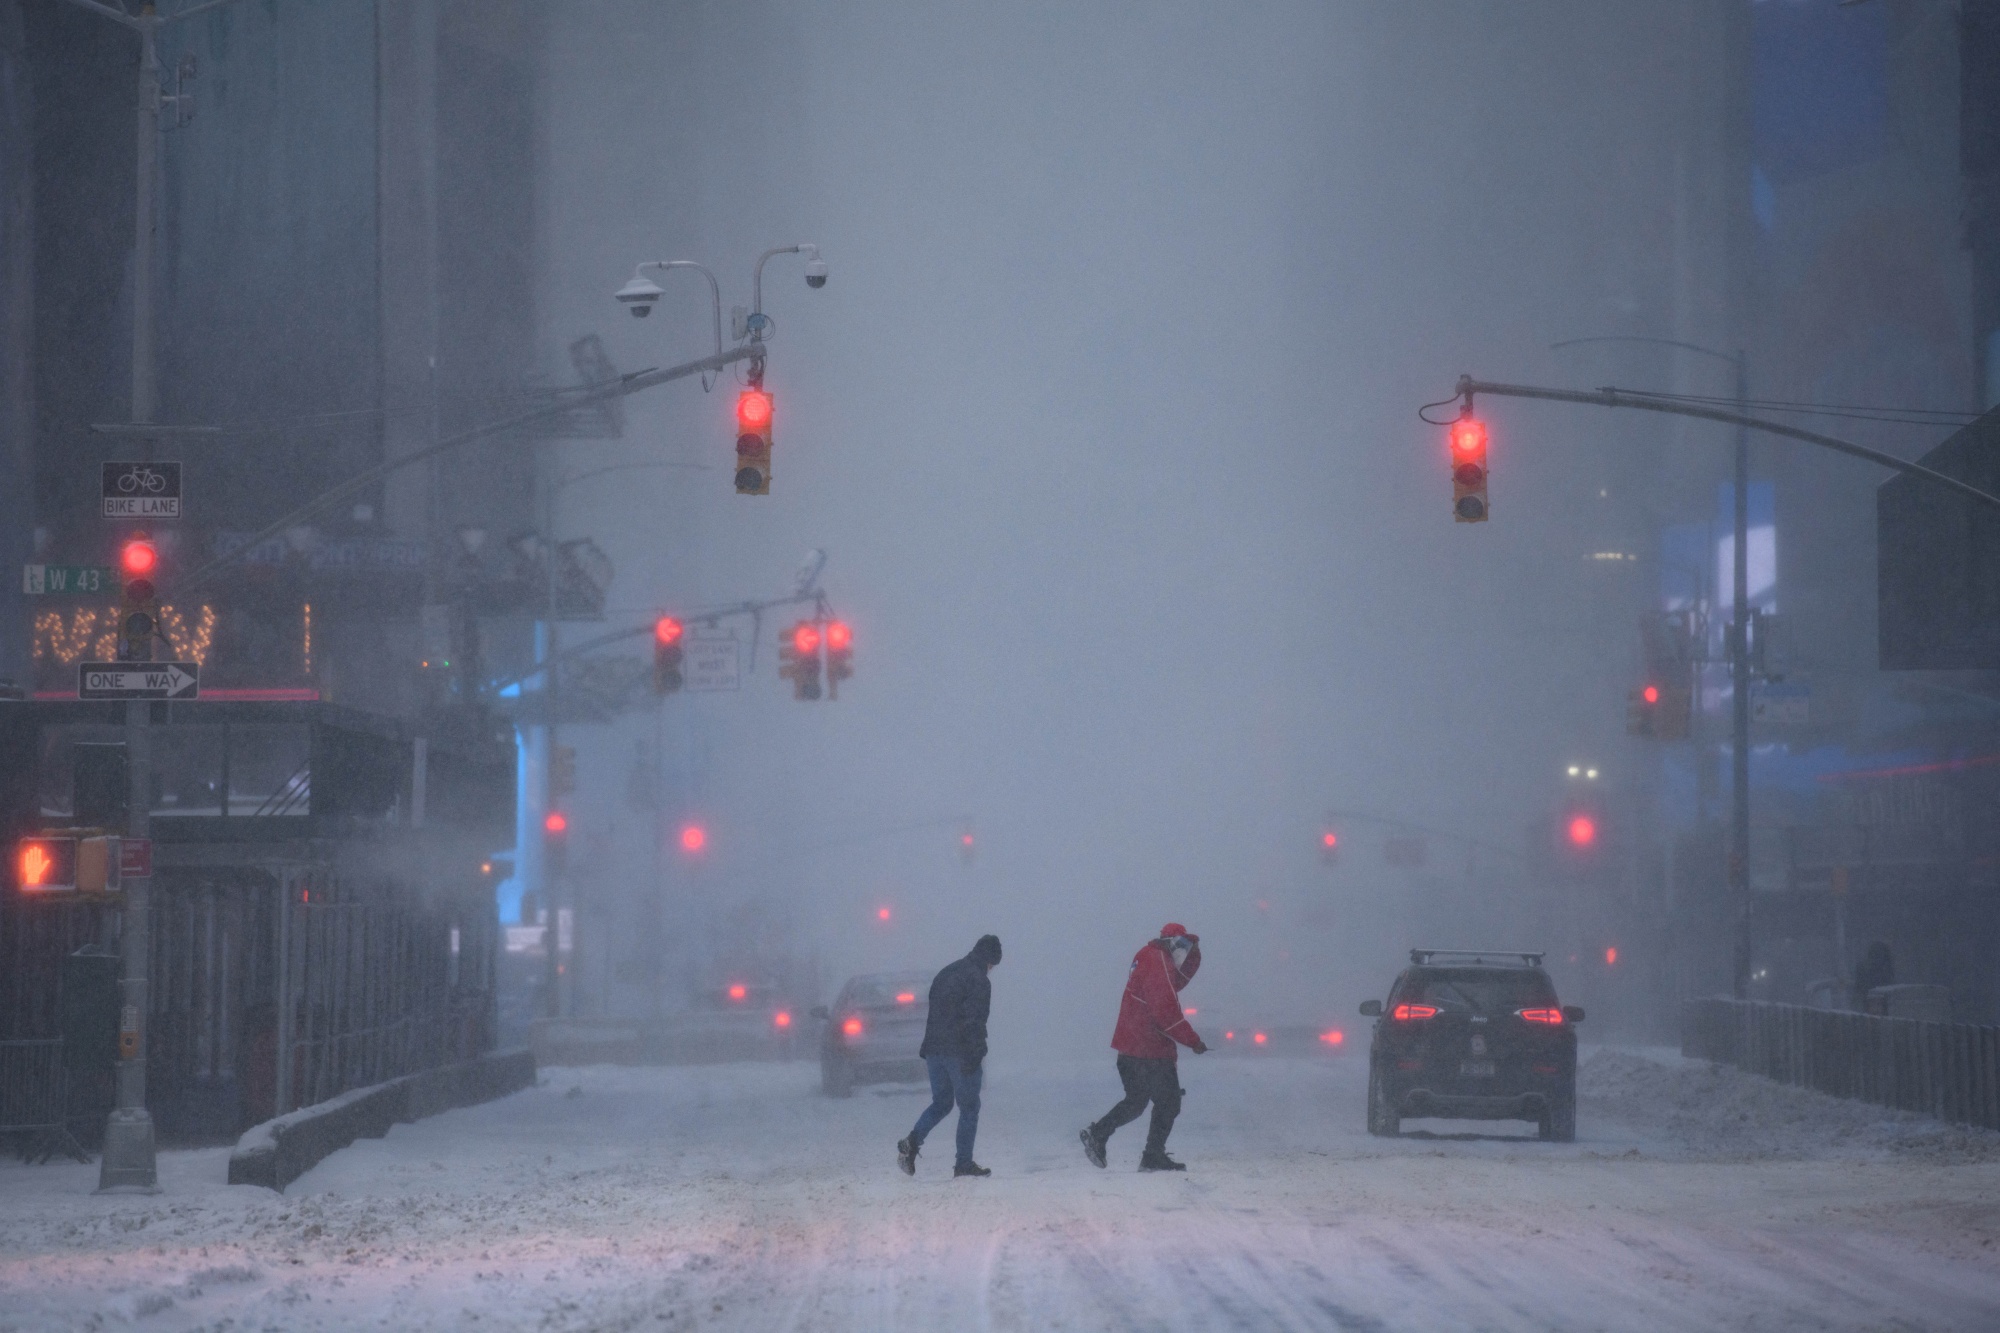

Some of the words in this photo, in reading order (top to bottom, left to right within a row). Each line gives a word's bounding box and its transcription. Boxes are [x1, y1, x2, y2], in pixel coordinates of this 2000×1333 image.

[106, 499, 135, 513] BIKE
[142, 499, 177, 513] LANE
[50, 569, 67, 590] W
[77, 569, 99, 591] 43
[90, 673, 125, 688] ONE
[145, 673, 182, 688] WAY
[1470, 1015, 1488, 1023] Jeep
